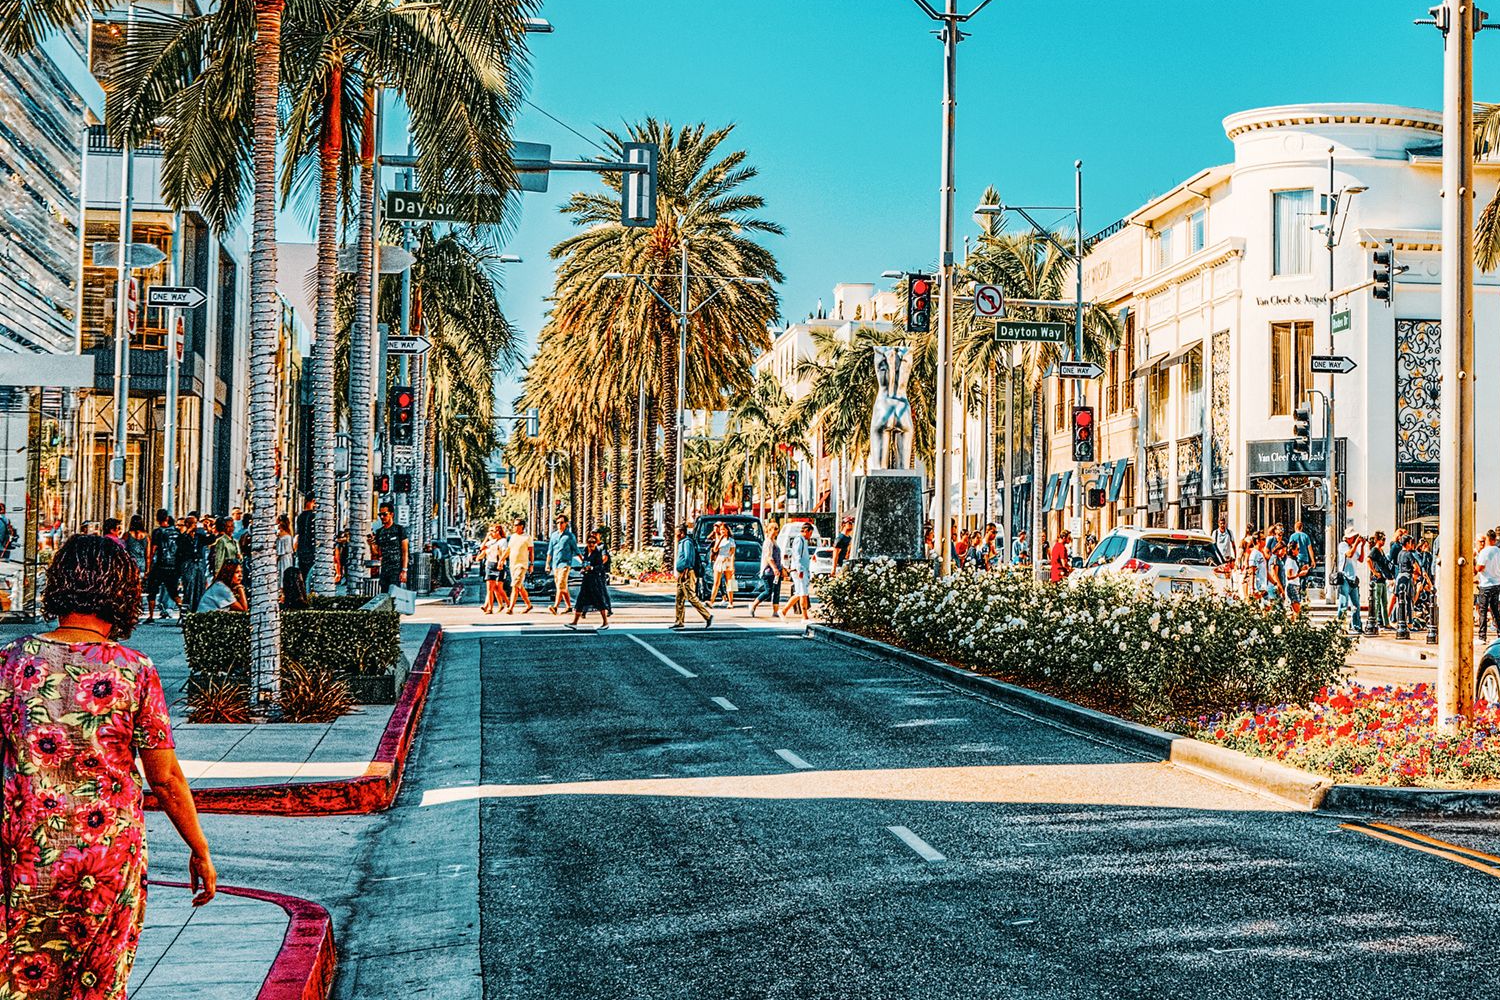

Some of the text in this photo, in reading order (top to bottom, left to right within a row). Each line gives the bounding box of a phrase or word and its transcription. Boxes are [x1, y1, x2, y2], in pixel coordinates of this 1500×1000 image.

[394, 198, 454, 217] Dayton
[152, 293, 187, 301] ONE WAY
[1001, 325, 1061, 340] Dayton Way
[401, 341, 415, 349] WAY
[1328, 361, 1342, 369] WAY
[1076, 367, 1090, 375] WAY
[1258, 453, 1270, 463] Van
[1270, 451, 1291, 463] Cleef
[1409, 476, 1438, 484] Van Cleef
[381, 477, 388, 492] 6
